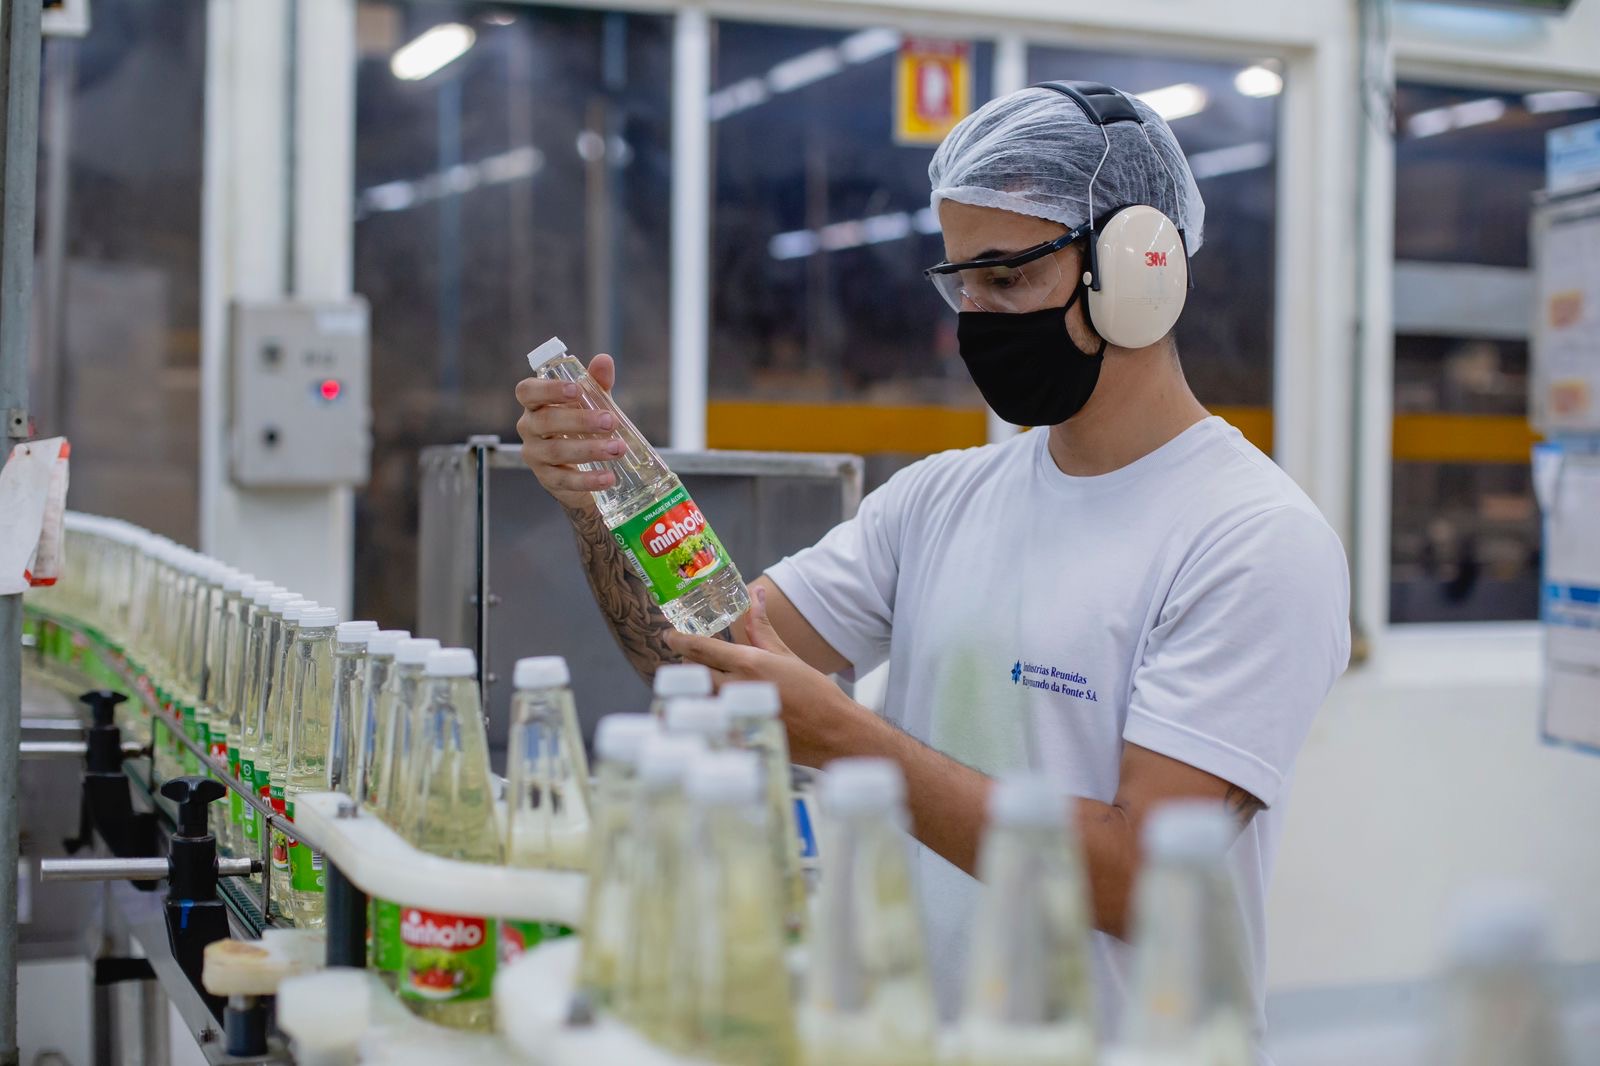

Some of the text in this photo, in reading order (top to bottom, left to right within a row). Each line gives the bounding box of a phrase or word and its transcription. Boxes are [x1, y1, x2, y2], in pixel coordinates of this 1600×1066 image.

[1144, 251, 1167, 267] 3M
[649, 510, 704, 553] minhoto
[1051, 667, 1087, 684] Reunidas
[1051, 682, 1060, 692] da
[1062, 683, 1084, 698] Fonte
